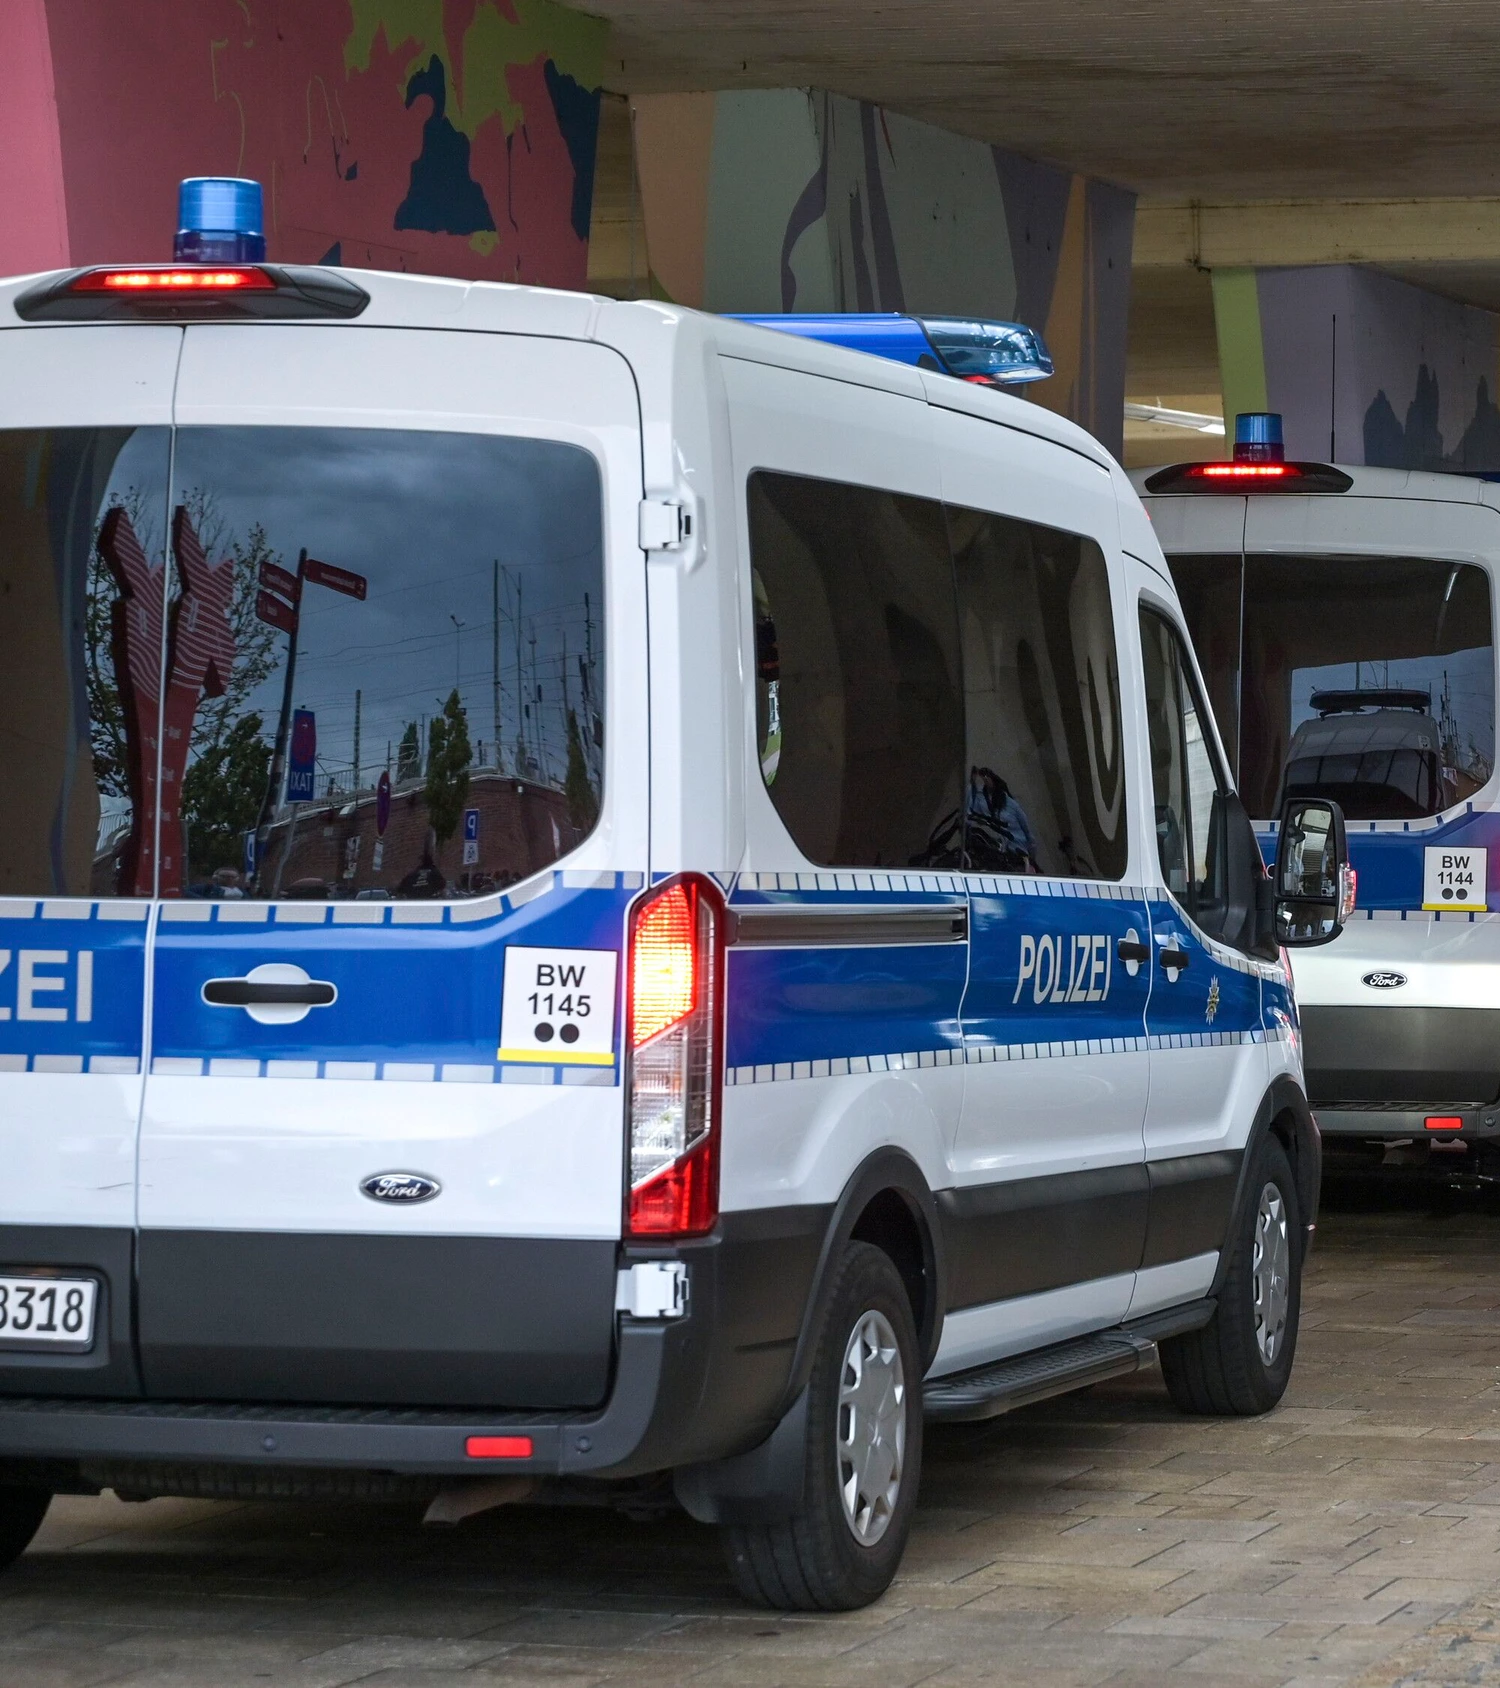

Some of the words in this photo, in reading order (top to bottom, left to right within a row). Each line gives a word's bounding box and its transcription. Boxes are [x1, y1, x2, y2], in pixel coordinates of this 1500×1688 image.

[1442, 855, 1470, 869] BW
[1437, 871, 1474, 885] 1144
[536, 963, 586, 988] BW
[1011, 933, 1112, 1005] POLIZEI
[1369, 973, 1399, 986] Ford
[0, 949, 94, 1023] EI
[527, 992, 591, 1017] 1145
[374, 1177, 422, 1197] Ford
